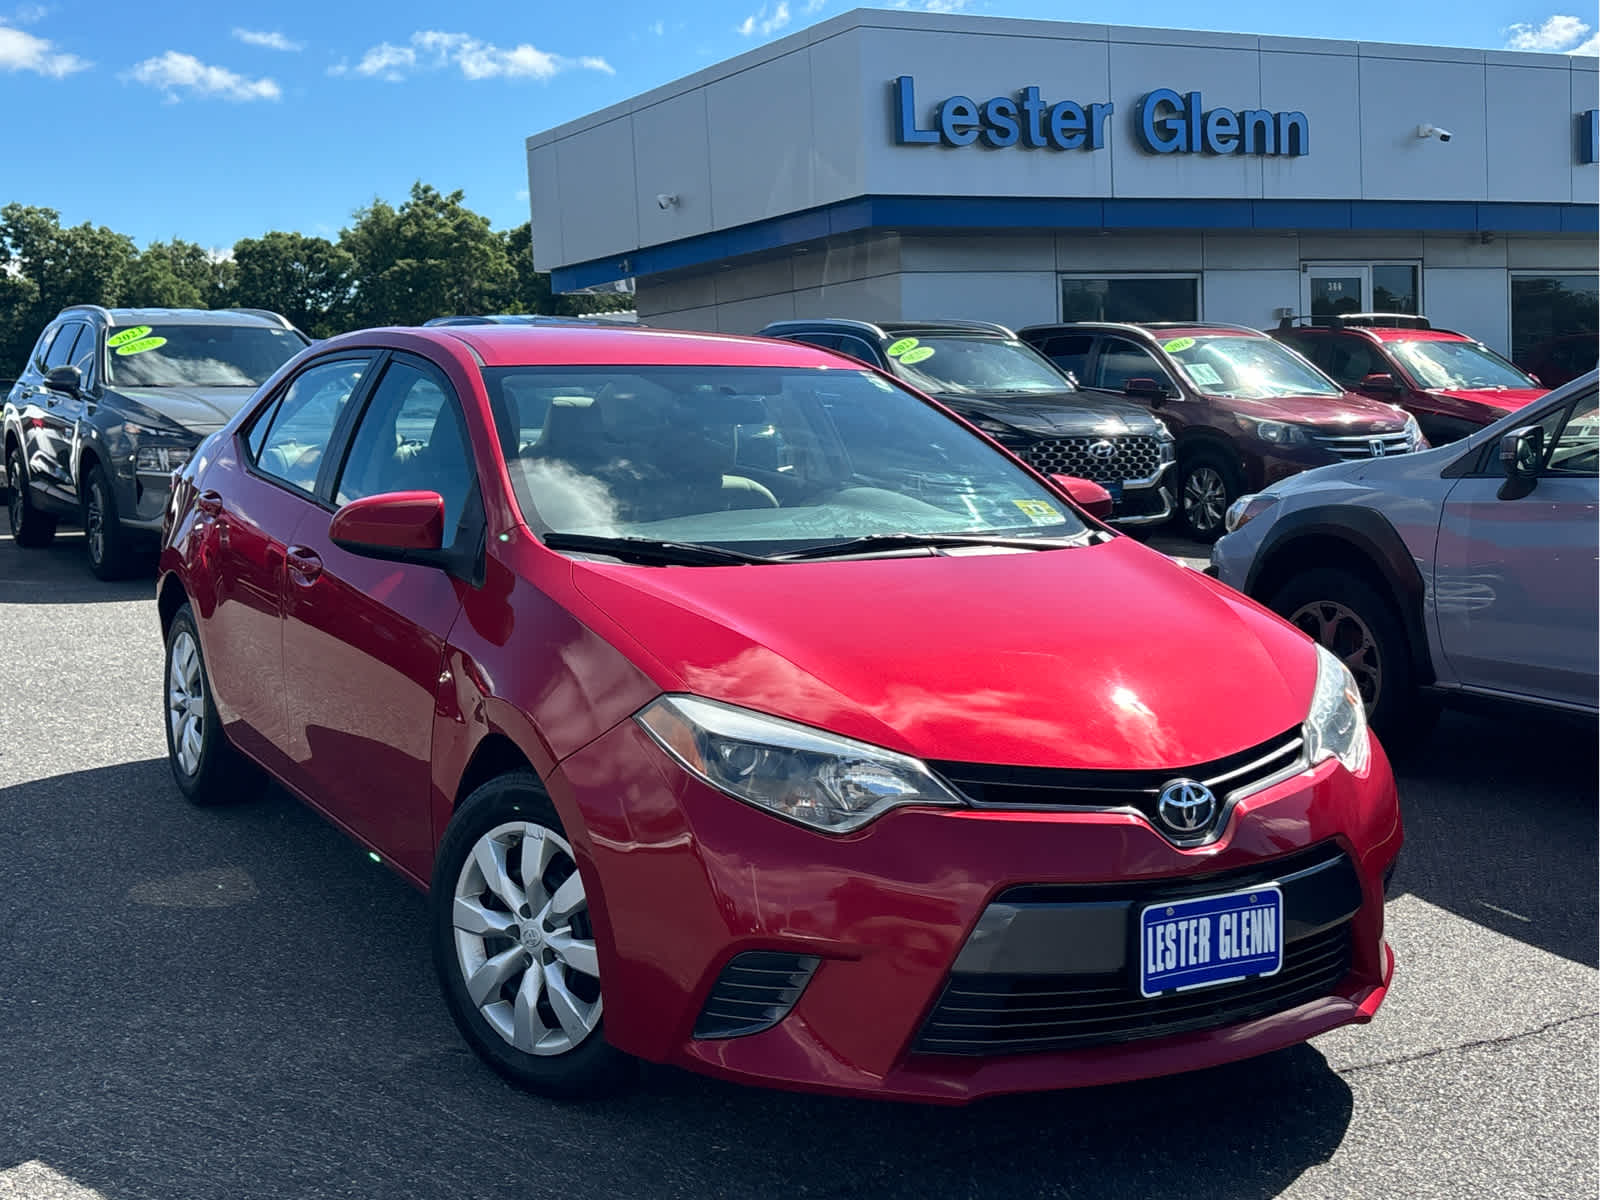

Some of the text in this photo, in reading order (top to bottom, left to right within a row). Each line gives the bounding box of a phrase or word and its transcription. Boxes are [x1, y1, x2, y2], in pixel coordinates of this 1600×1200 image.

[896, 75, 1310, 156] Lester Glenn
[1147, 907, 1276, 974] LESTER GLENN
